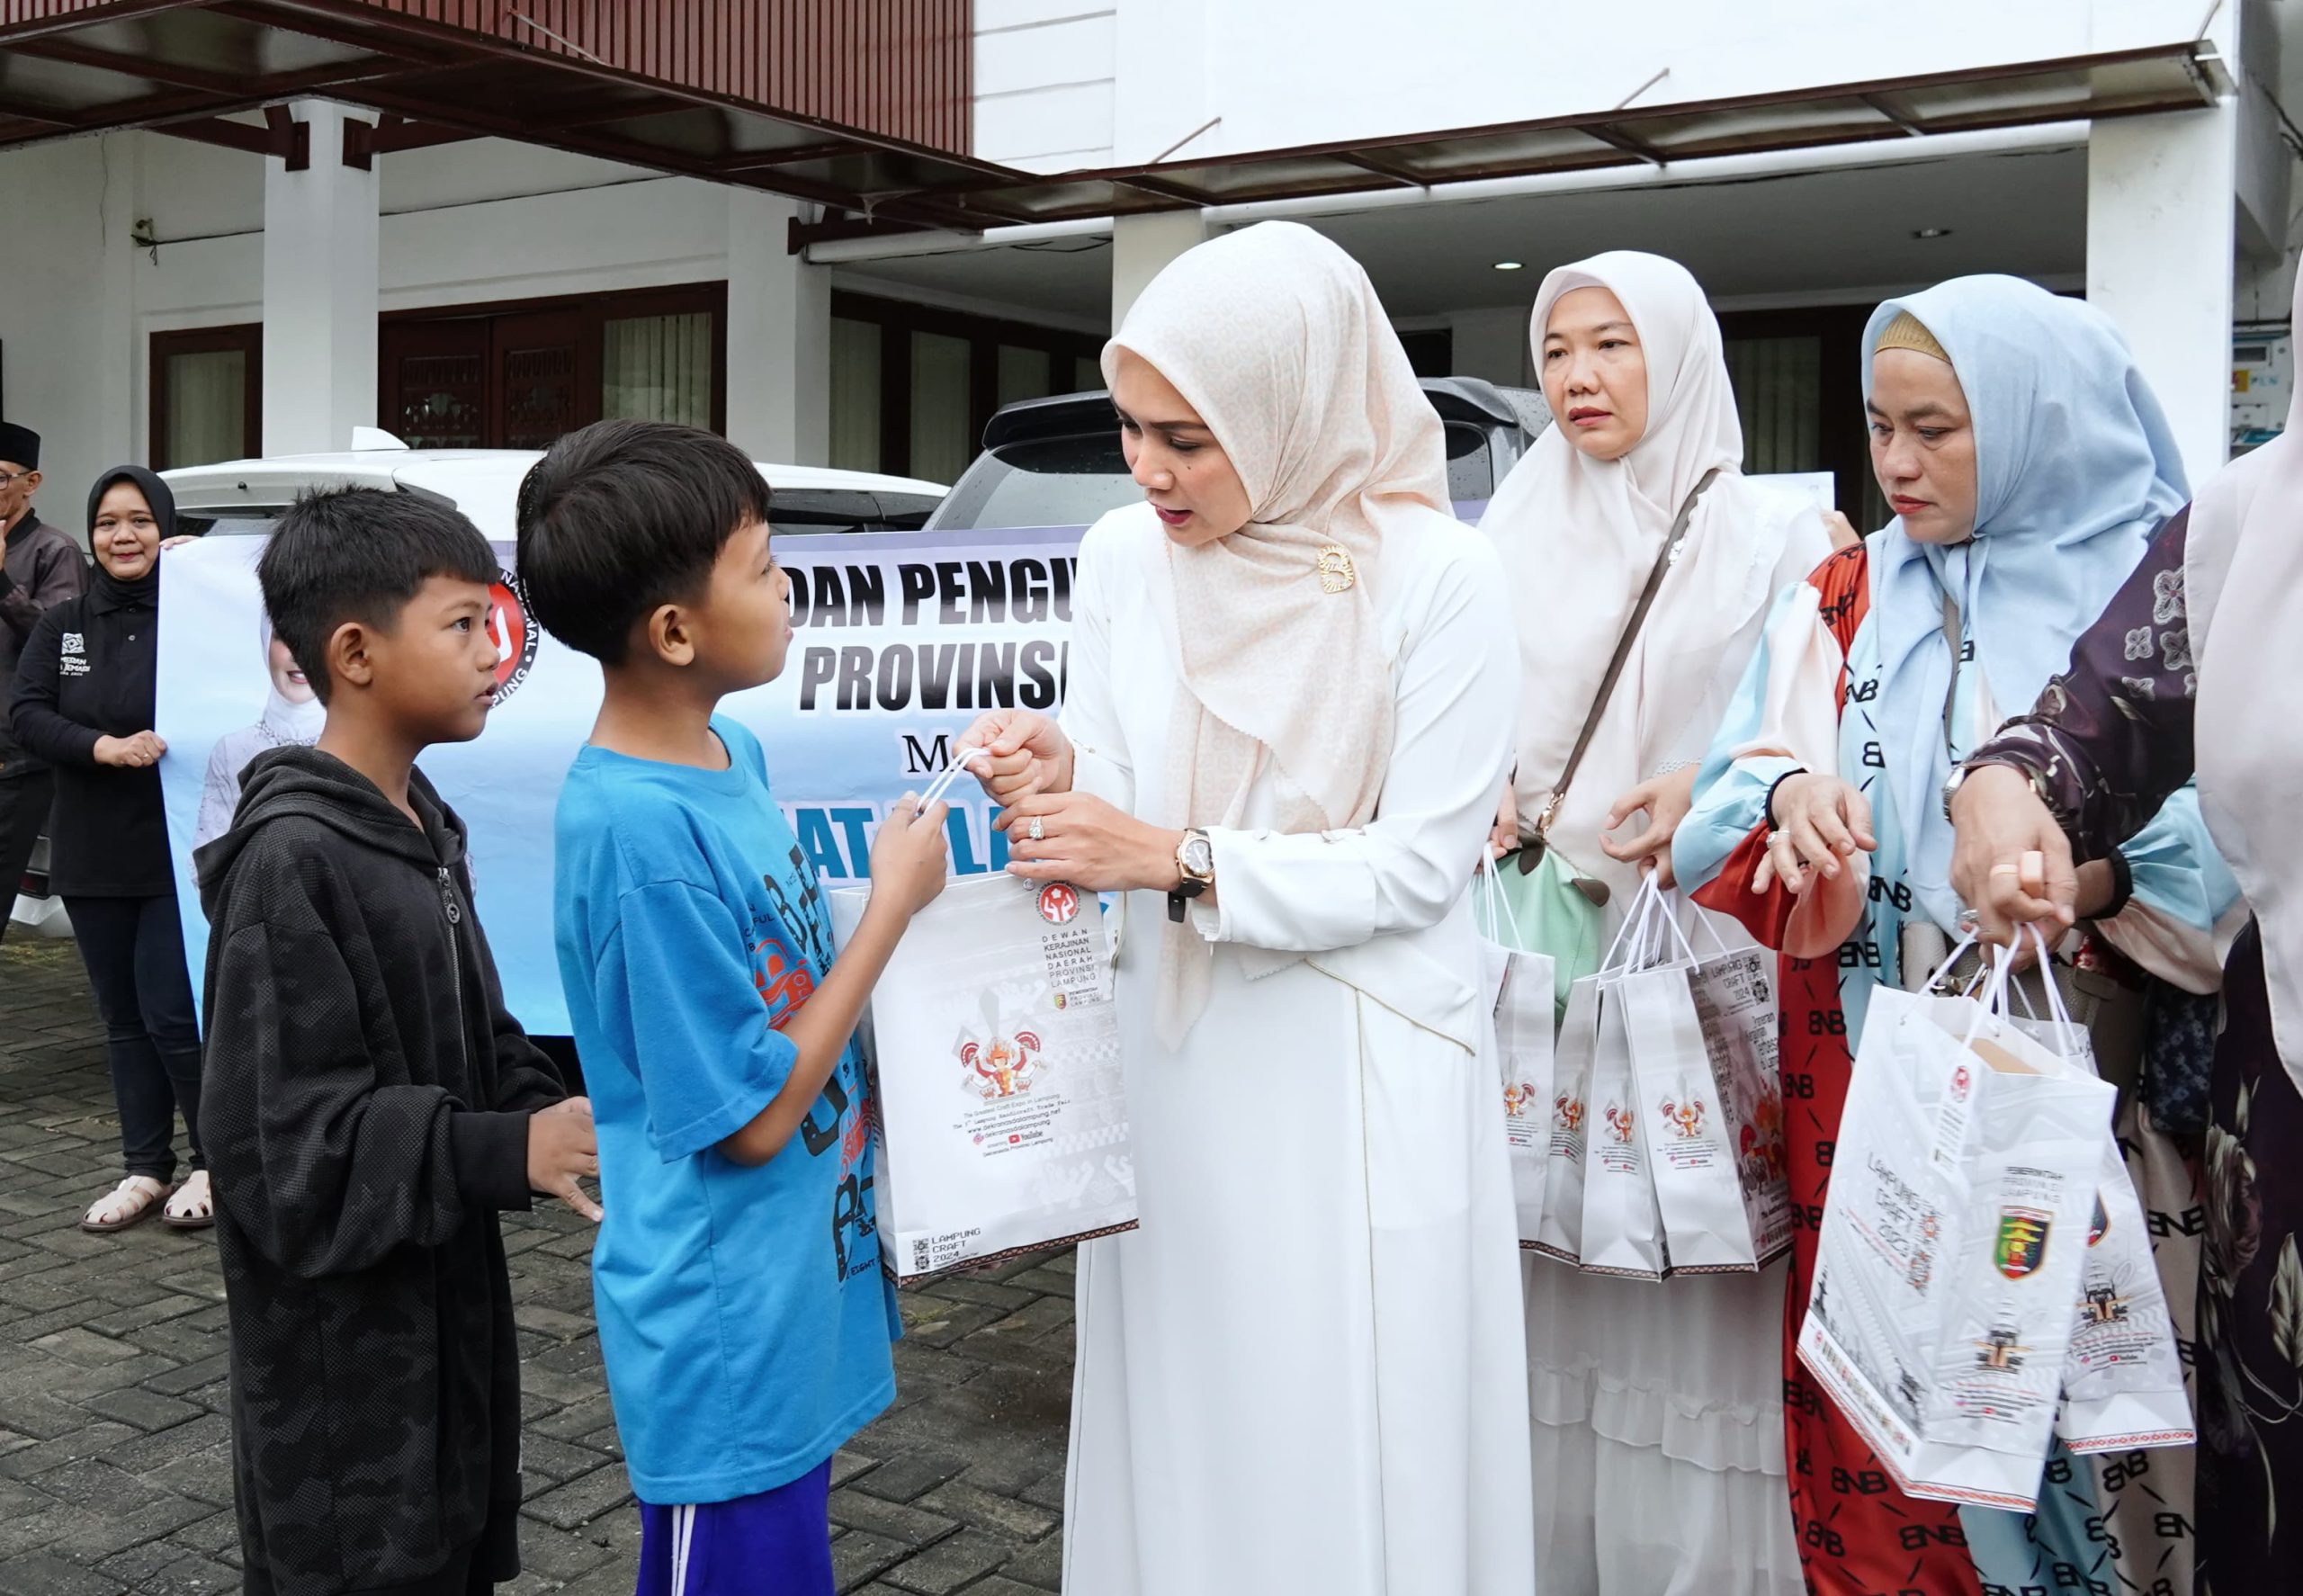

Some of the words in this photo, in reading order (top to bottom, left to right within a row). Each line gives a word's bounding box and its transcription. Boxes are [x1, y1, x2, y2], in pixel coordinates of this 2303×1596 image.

[897, 558, 1078, 626] PENGU
[492, 668, 528, 708] PUNG
[1042, 928, 1088, 943] DEWAN
[1044, 937, 1089, 952] KERAJINAN
[1045, 946, 1092, 961] NASIONAL
[1047, 955, 1093, 970] DAERAH
[1049, 964, 1095, 979] PROVINSI
[1051, 973, 1097, 989] LAMPUNG
[931, 1227, 981, 1244] LAMPUNG
[932, 1240, 966, 1253] CRAFT
[933, 1251, 960, 1263] 2024
